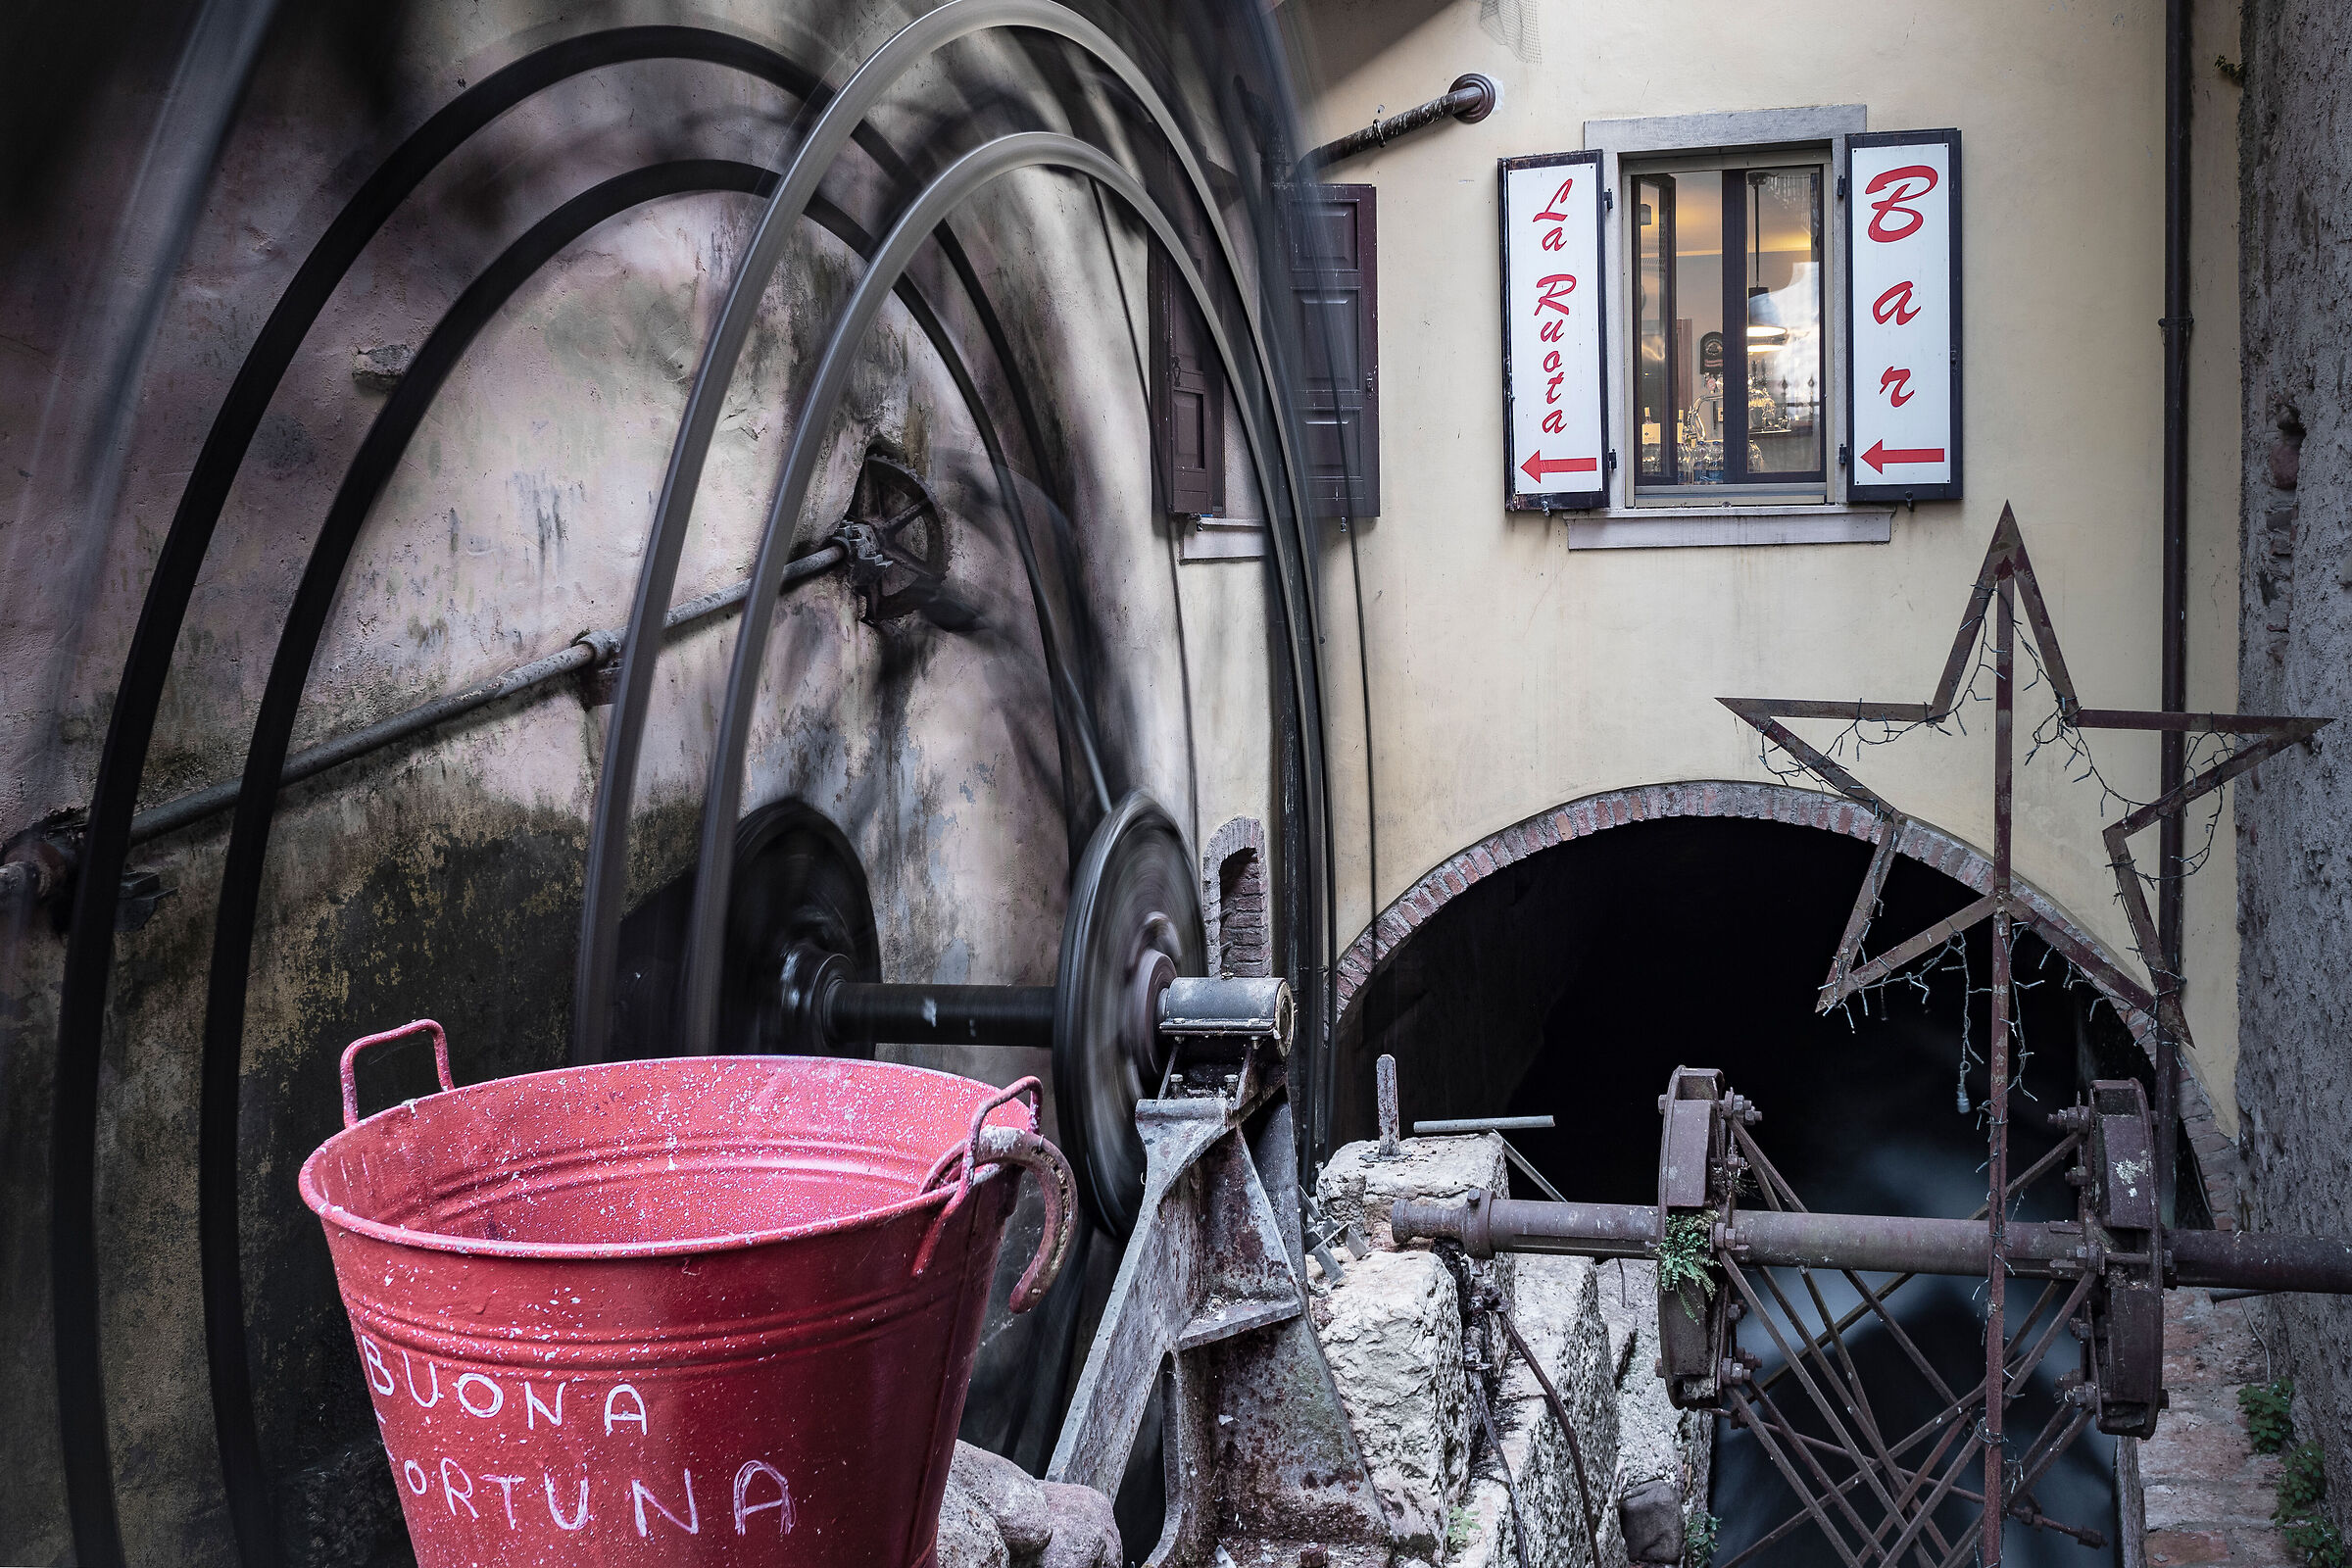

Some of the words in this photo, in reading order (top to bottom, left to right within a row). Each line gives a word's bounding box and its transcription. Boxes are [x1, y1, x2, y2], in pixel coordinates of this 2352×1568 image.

[1532, 177, 1574, 253] La
[1864, 165, 1939, 408] Bar
[1534, 273, 1578, 434] Ruota
[361, 1334, 649, 1437] BUONA
[374, 1407, 798, 1537] ORTUNA
